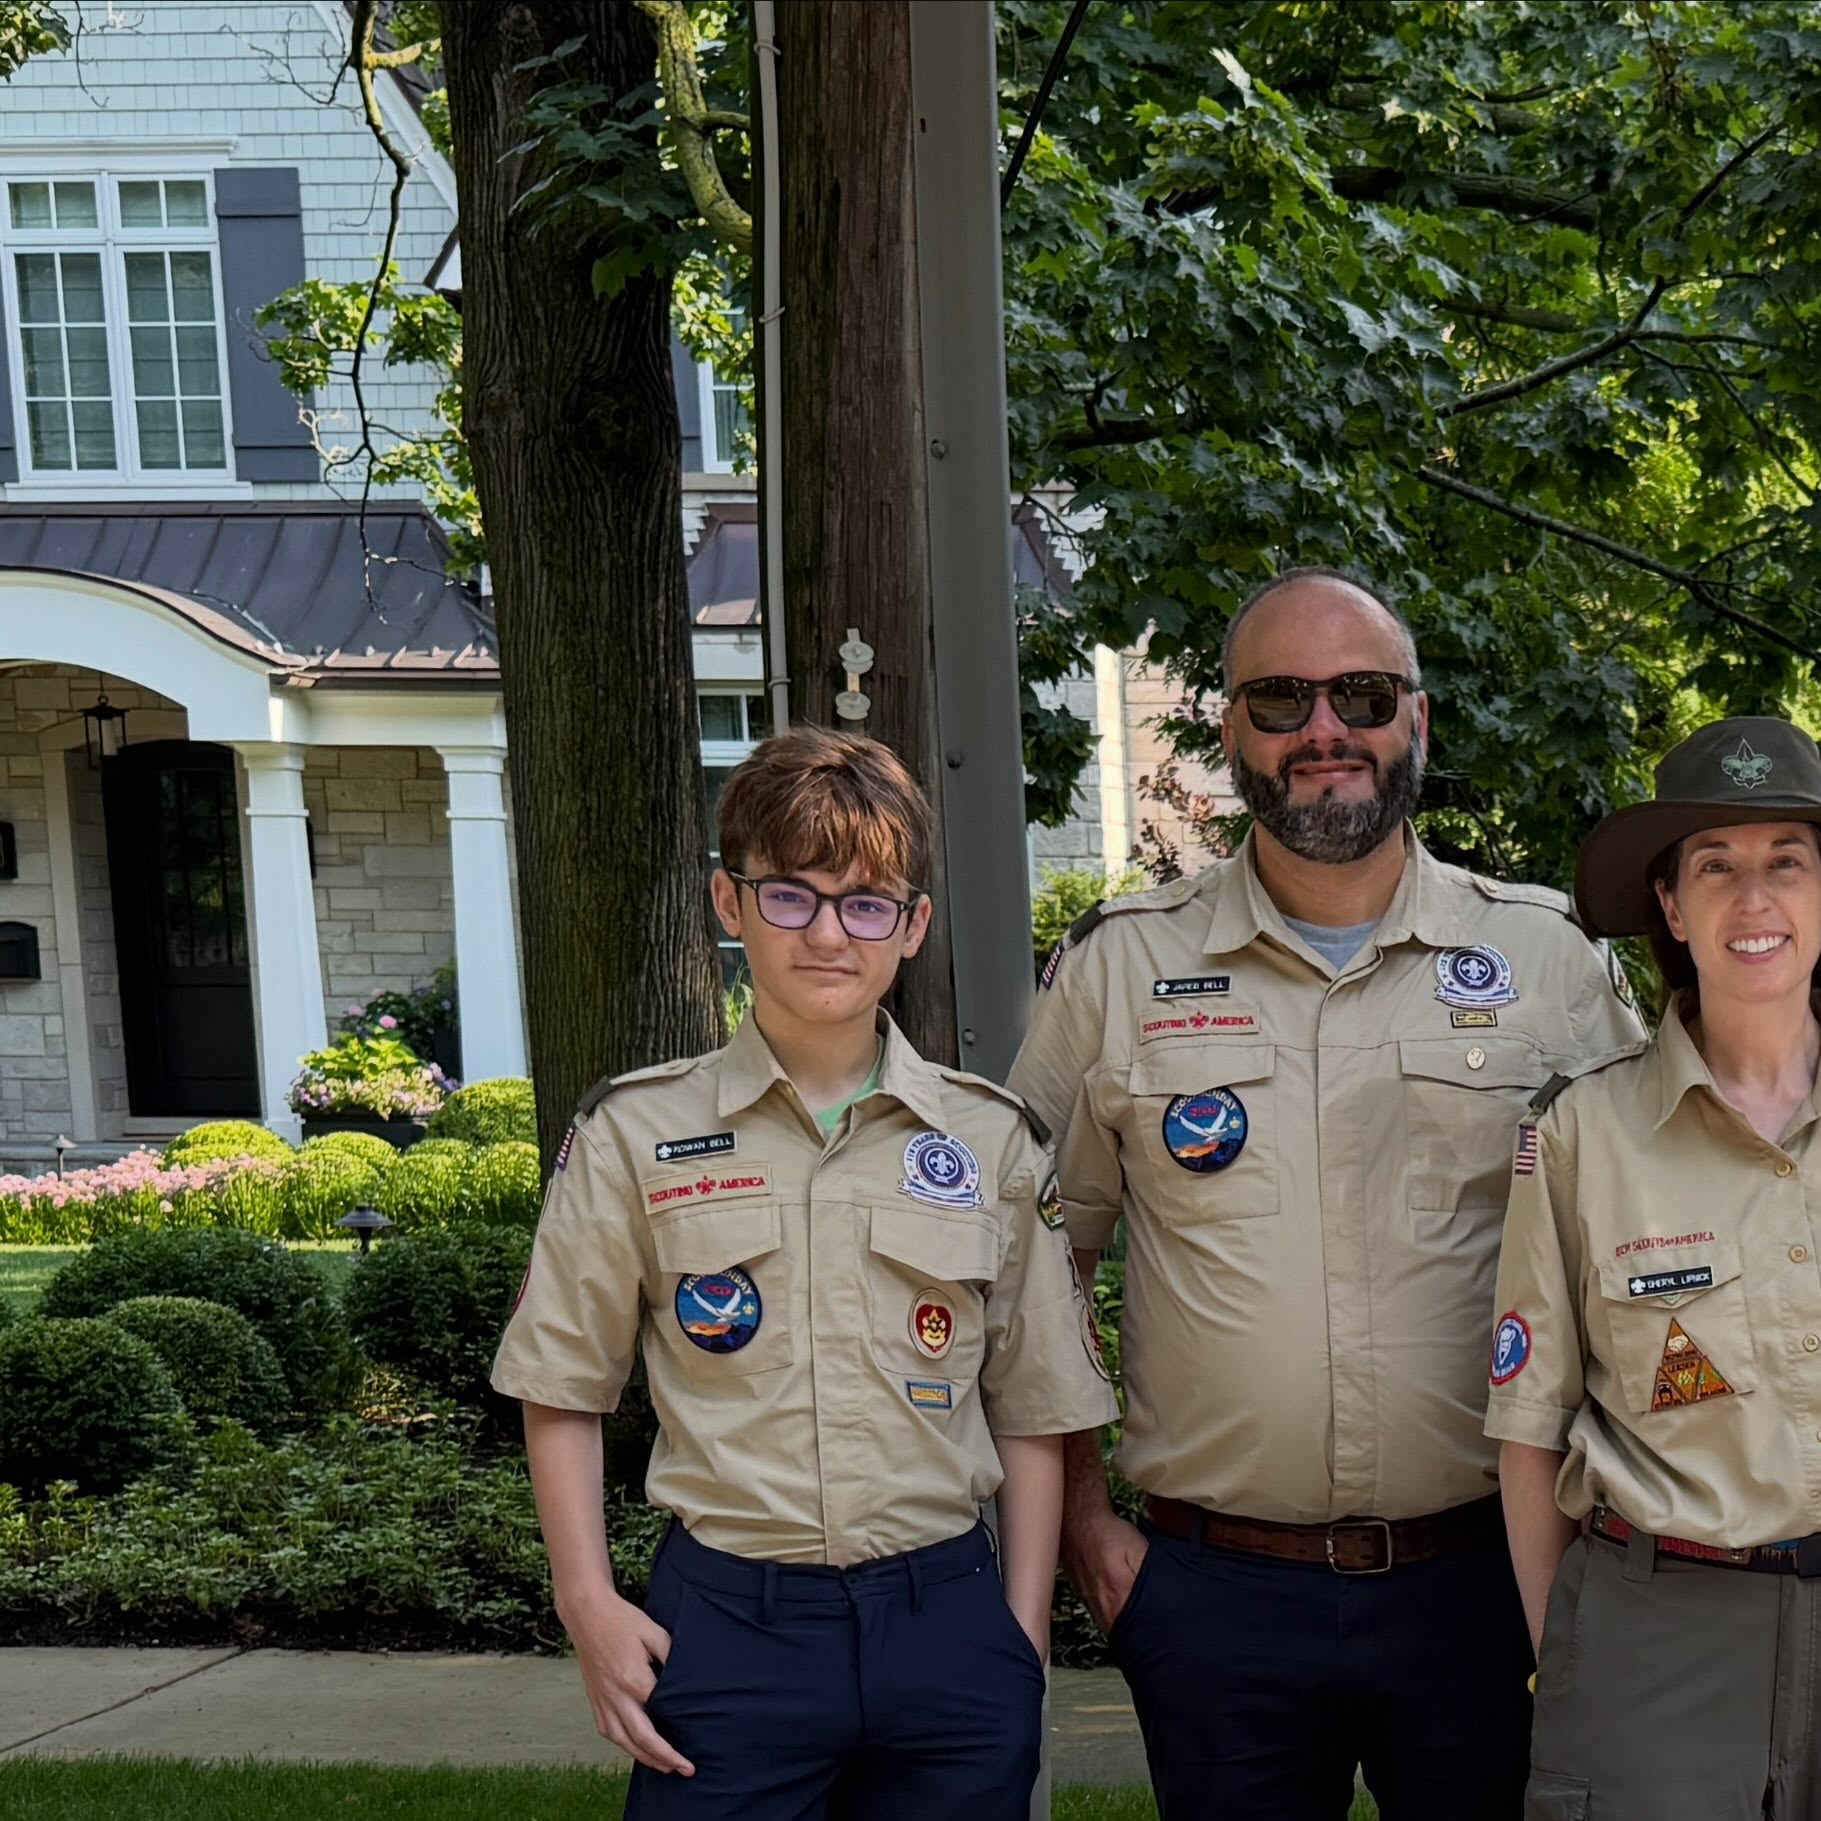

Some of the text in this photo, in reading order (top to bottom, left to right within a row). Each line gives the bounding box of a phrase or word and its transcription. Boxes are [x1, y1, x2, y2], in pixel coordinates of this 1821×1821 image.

[1203, 980, 1224, 989] BELL
[1143, 1015, 1254, 1034] SCOUTING AMERICA
[709, 1137, 732, 1149] BELL
[648, 1176, 766, 1205] SCOUTING AMERICA
[1675, 1231, 1715, 1246] AMERICA
